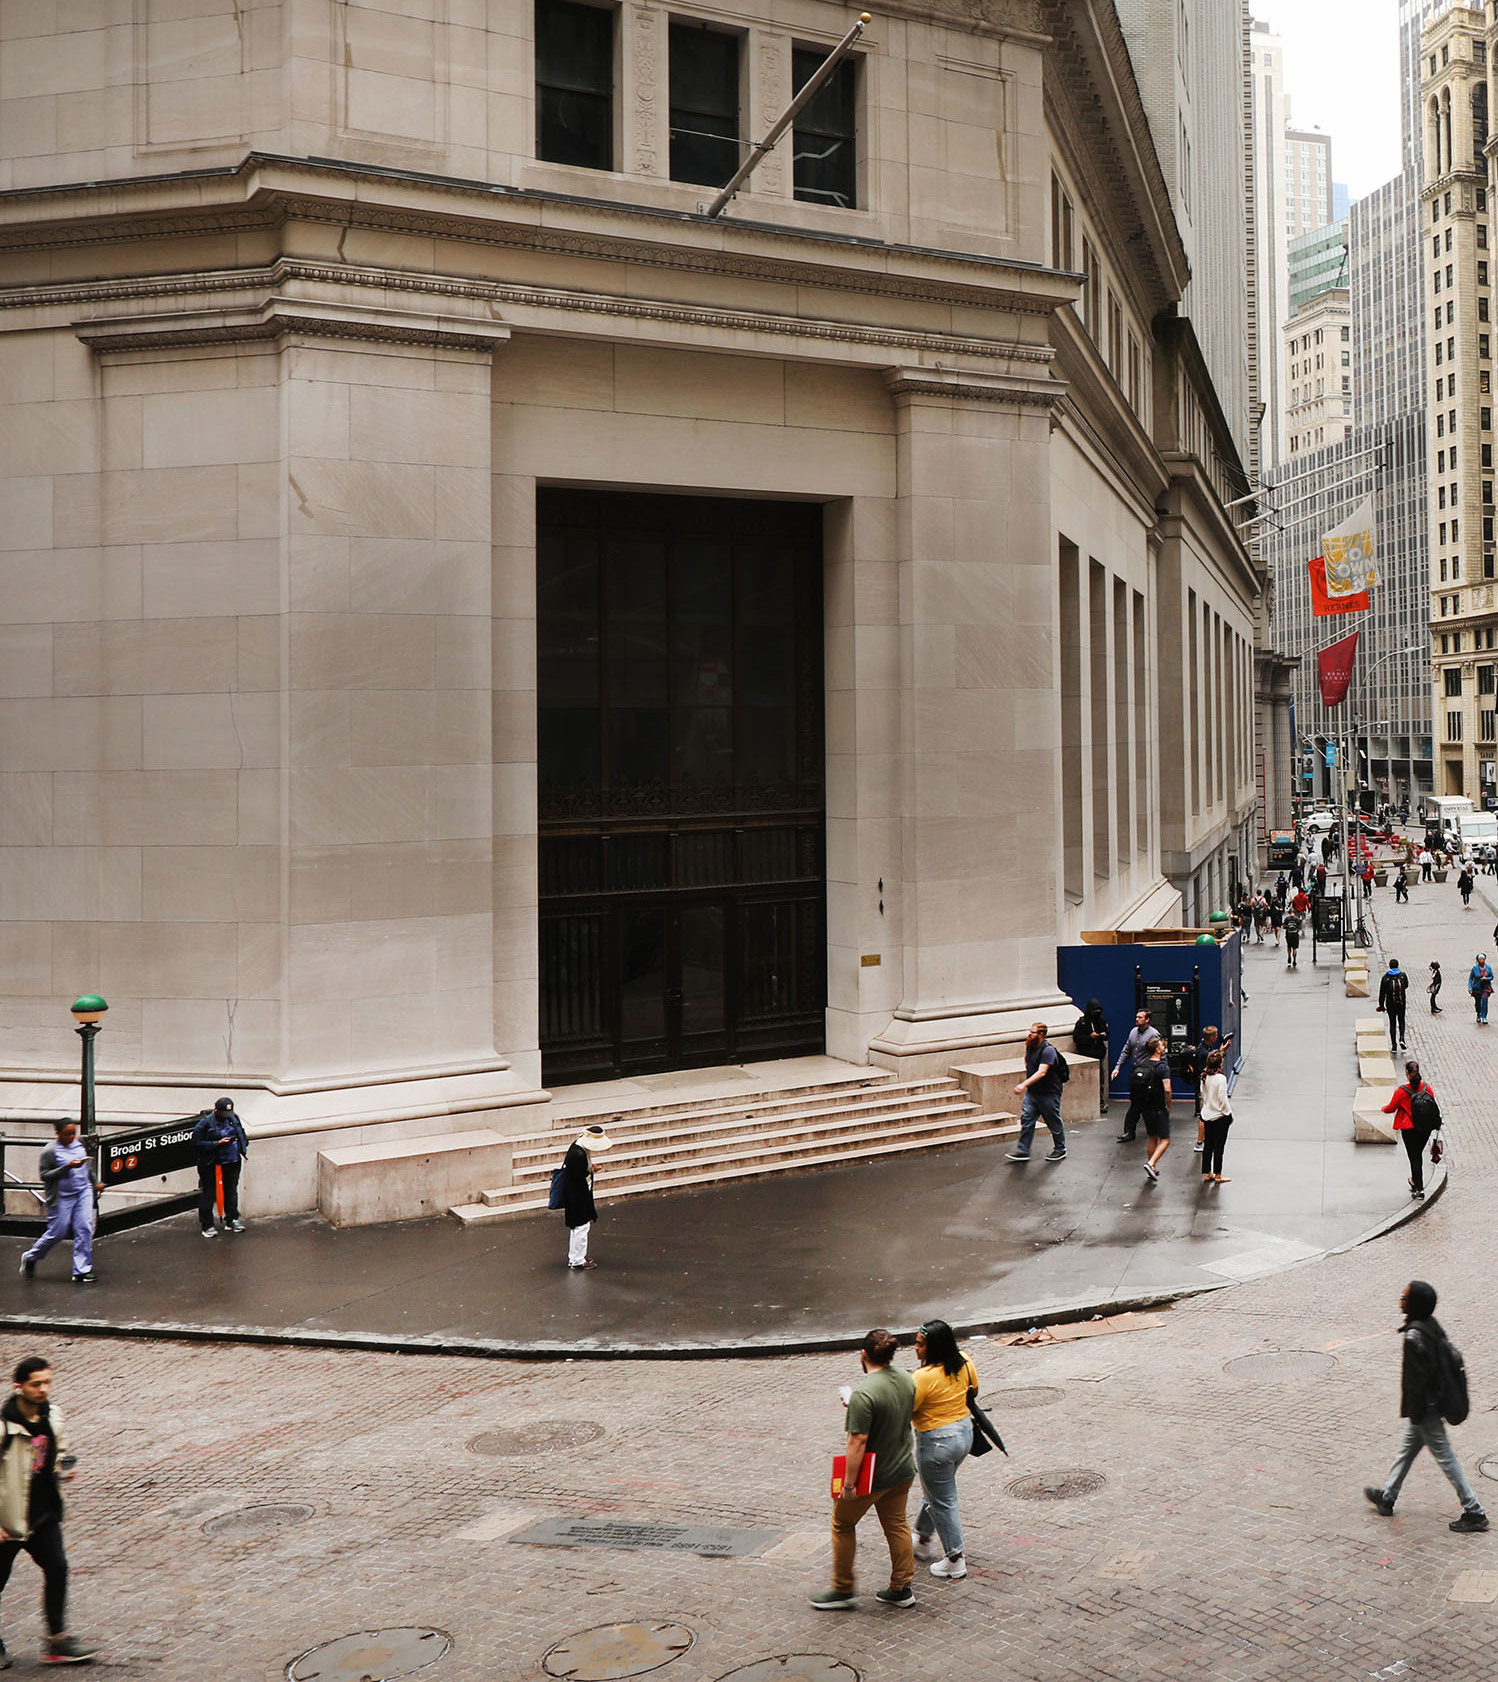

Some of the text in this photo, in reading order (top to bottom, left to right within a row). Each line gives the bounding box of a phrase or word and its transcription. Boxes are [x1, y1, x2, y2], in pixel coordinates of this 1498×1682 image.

[110, 1141, 142, 1157] Broad
[145, 1138, 157, 1149] St
[129, 1158, 134, 1166] Z
